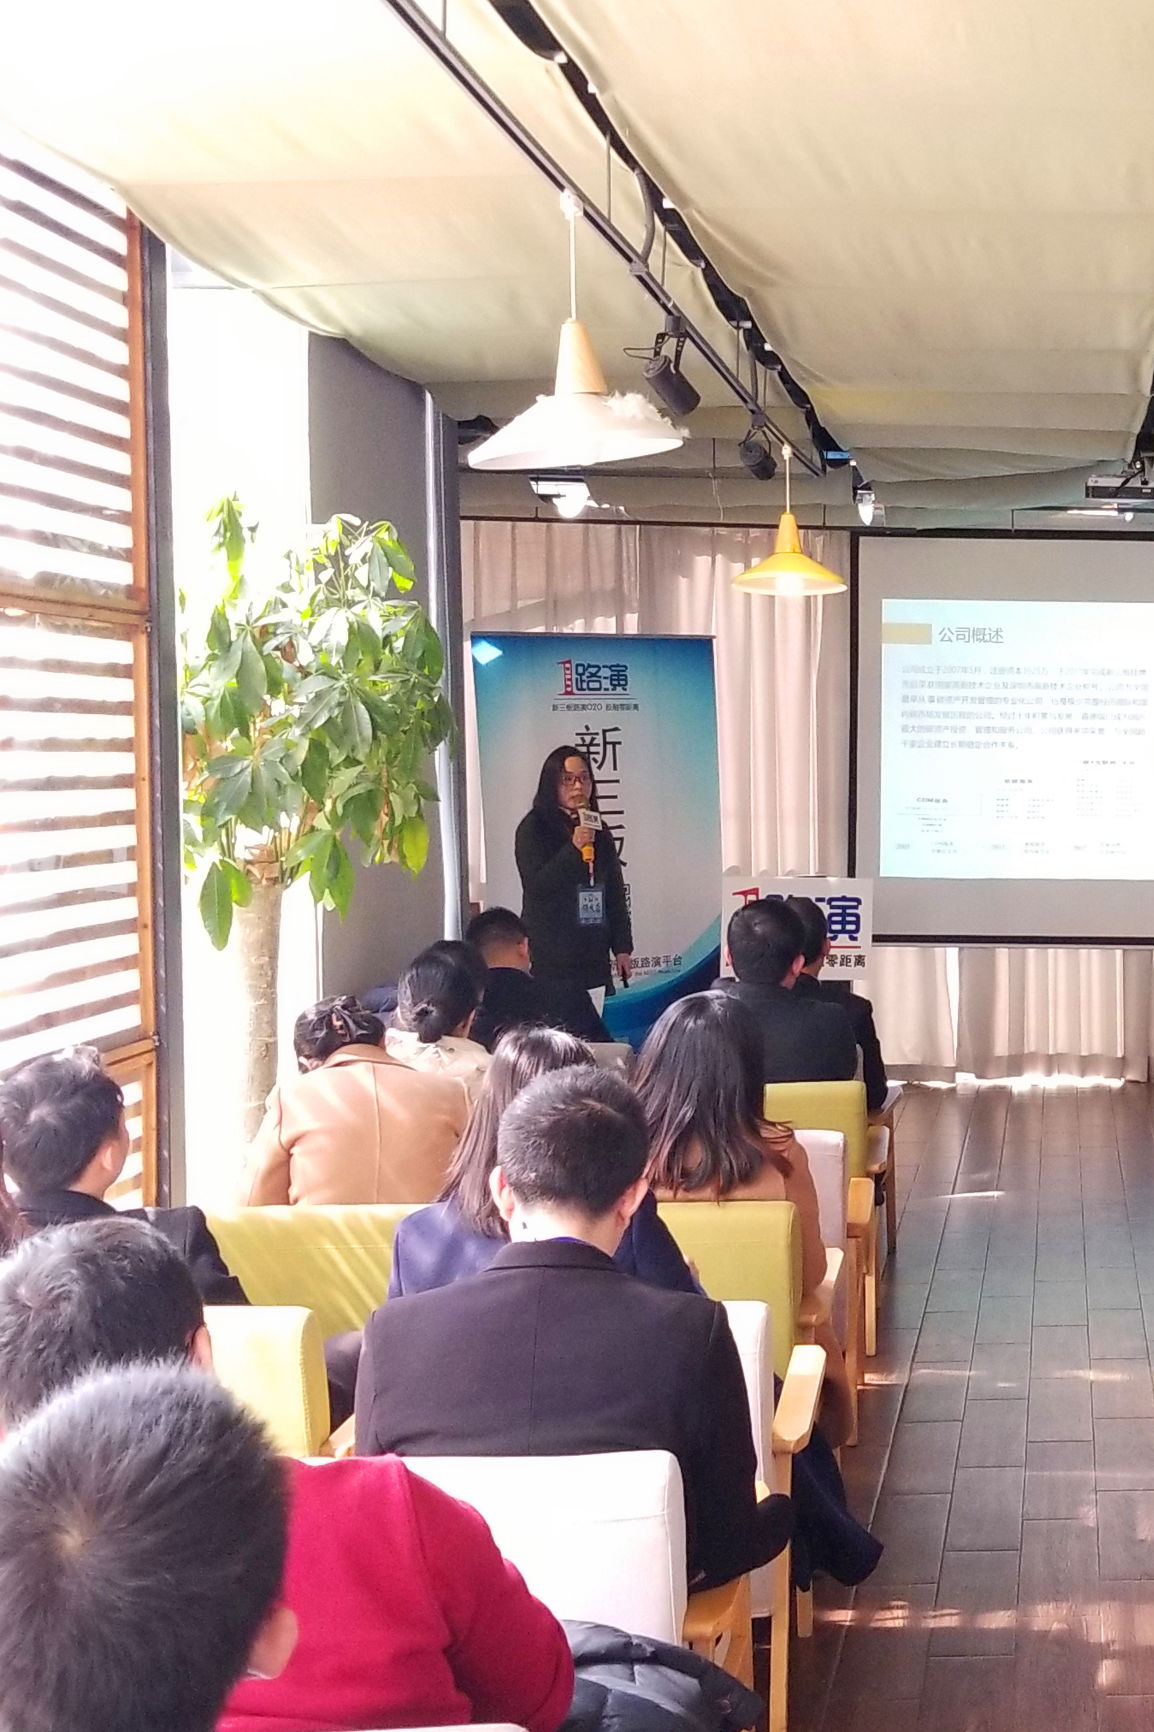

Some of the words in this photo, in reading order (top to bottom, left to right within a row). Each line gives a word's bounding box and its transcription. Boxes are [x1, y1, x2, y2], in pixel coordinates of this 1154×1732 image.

[938, 627, 1004, 643] 公司概述
[826, 954, 866, 967] 零距离
